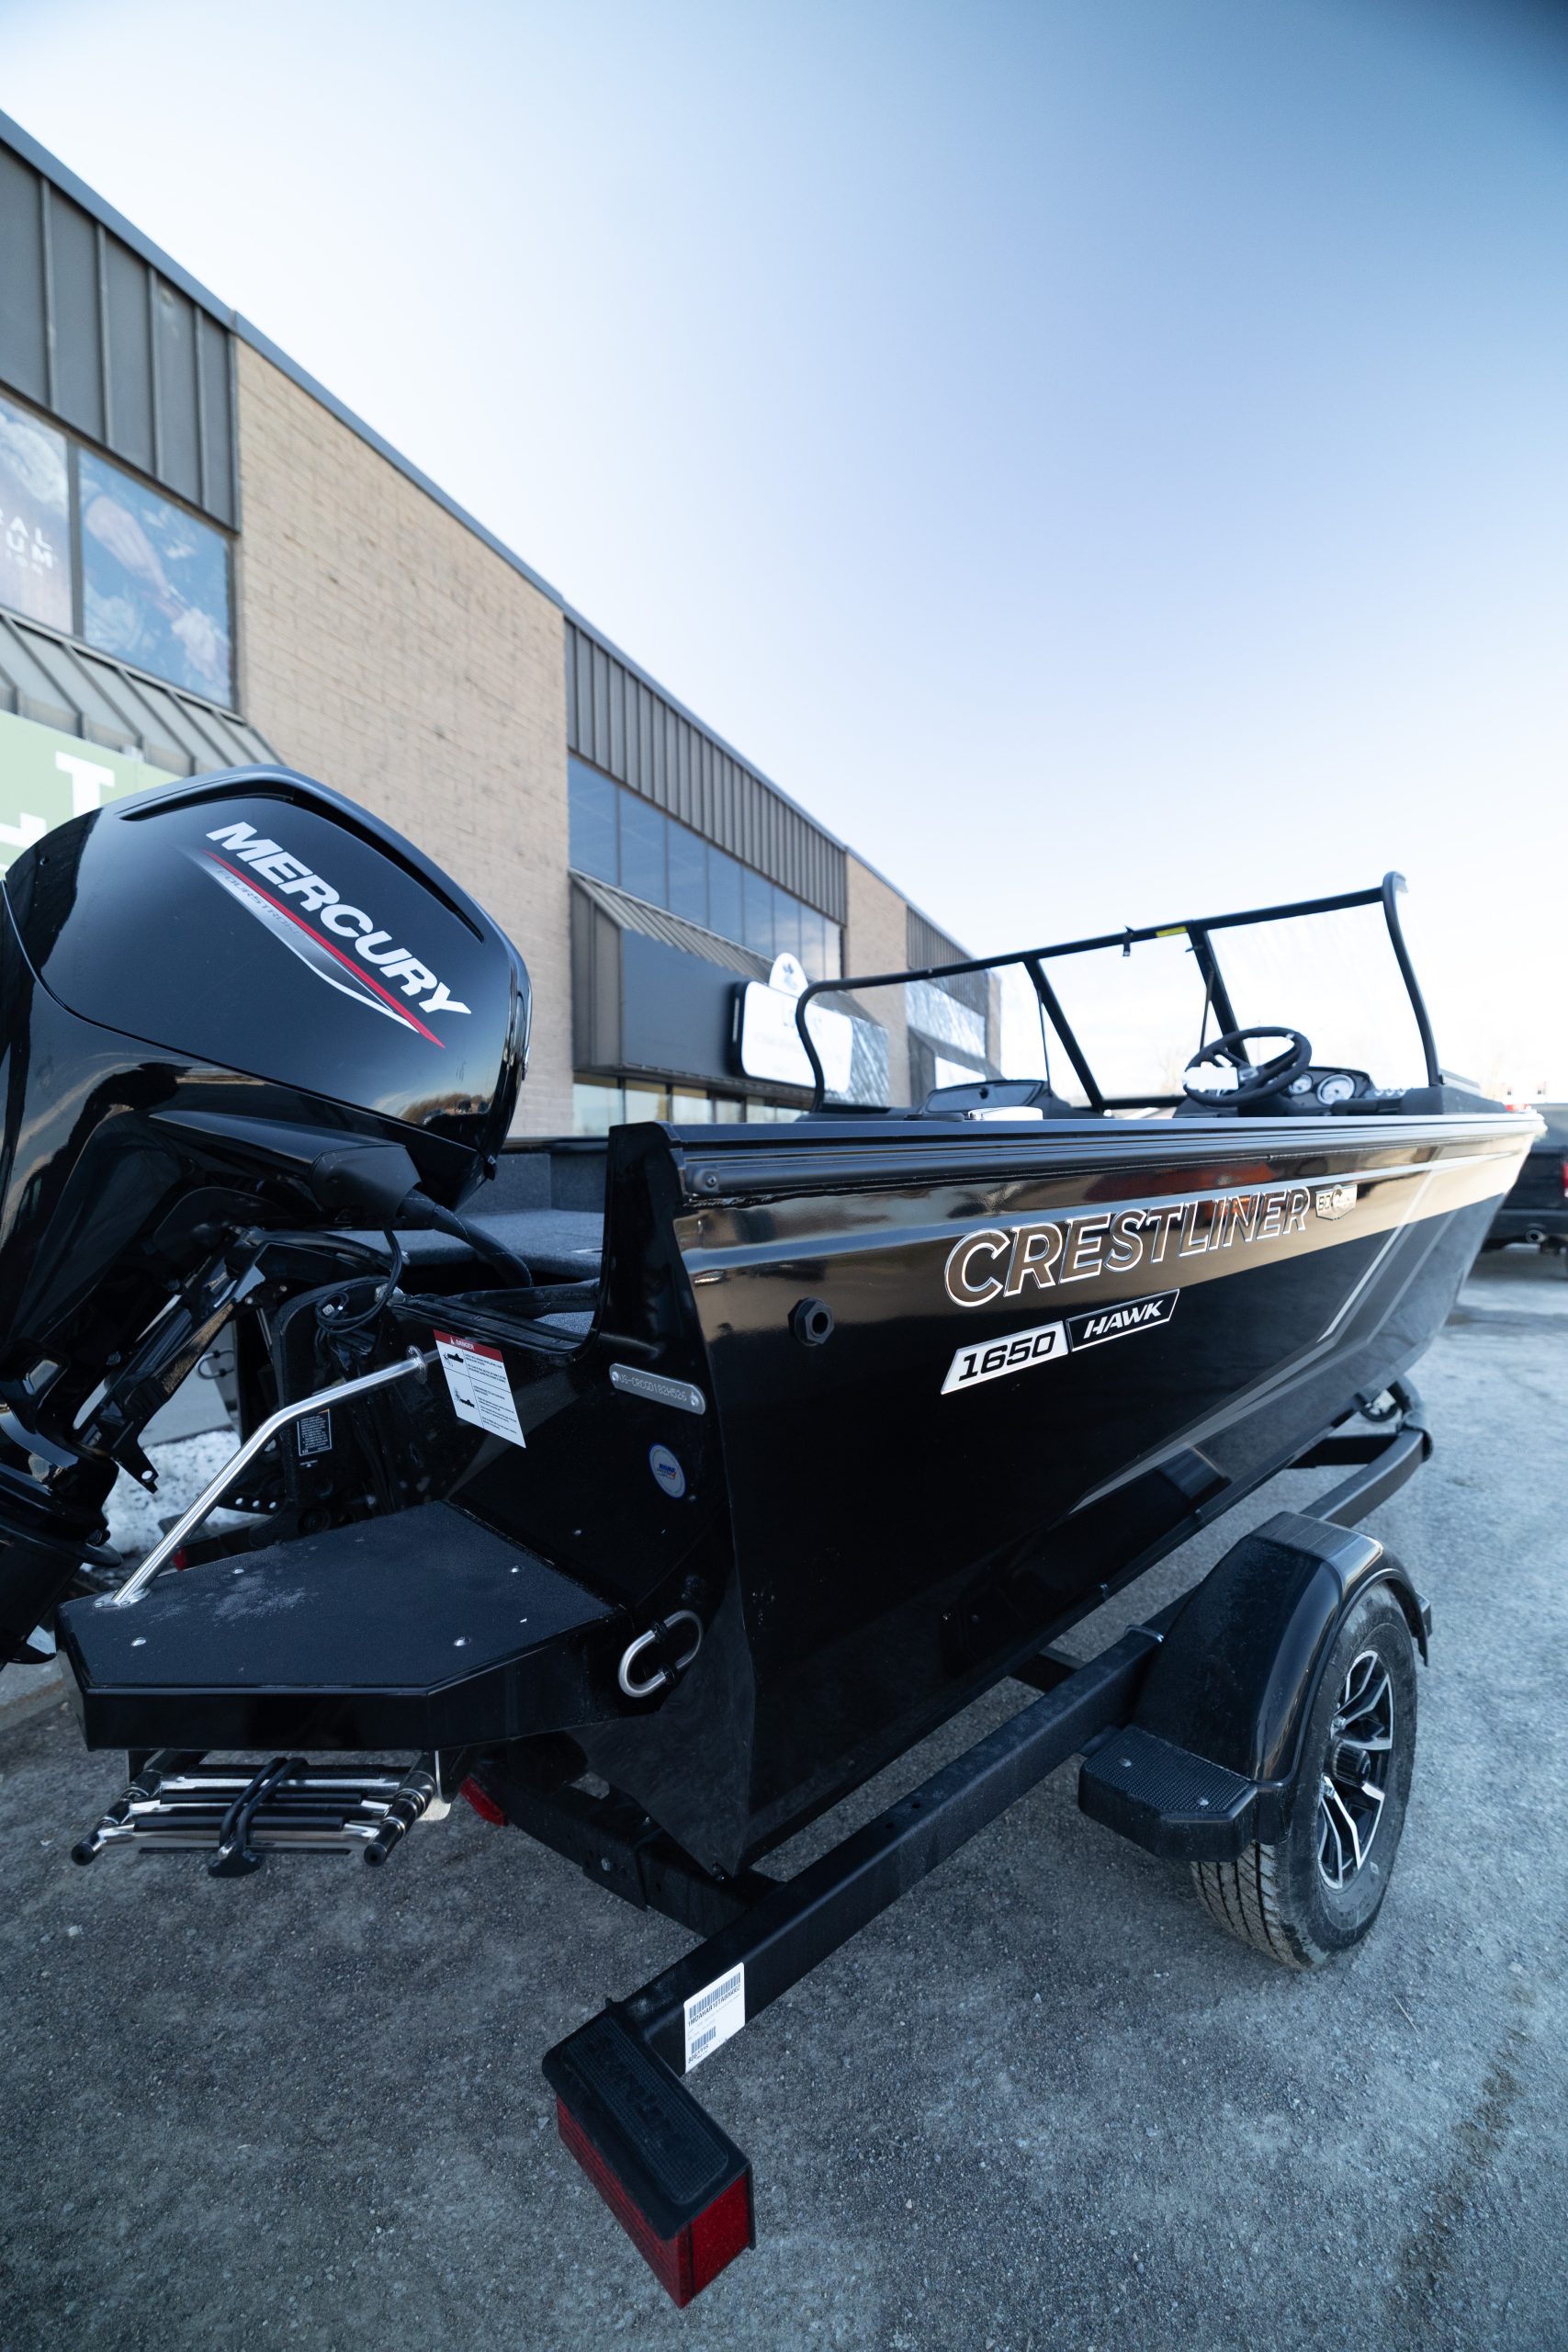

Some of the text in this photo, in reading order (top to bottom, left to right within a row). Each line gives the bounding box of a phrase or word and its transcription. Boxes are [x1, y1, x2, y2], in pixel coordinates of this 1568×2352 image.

[0, 507, 53, 552] AL
[206, 821, 471, 1014] MERCURY
[943, 1185, 1311, 1308] CRESTLINER
[456, 1339, 475, 1351] DANGER
[958, 1299, 1165, 1382] 1650 HAWK
